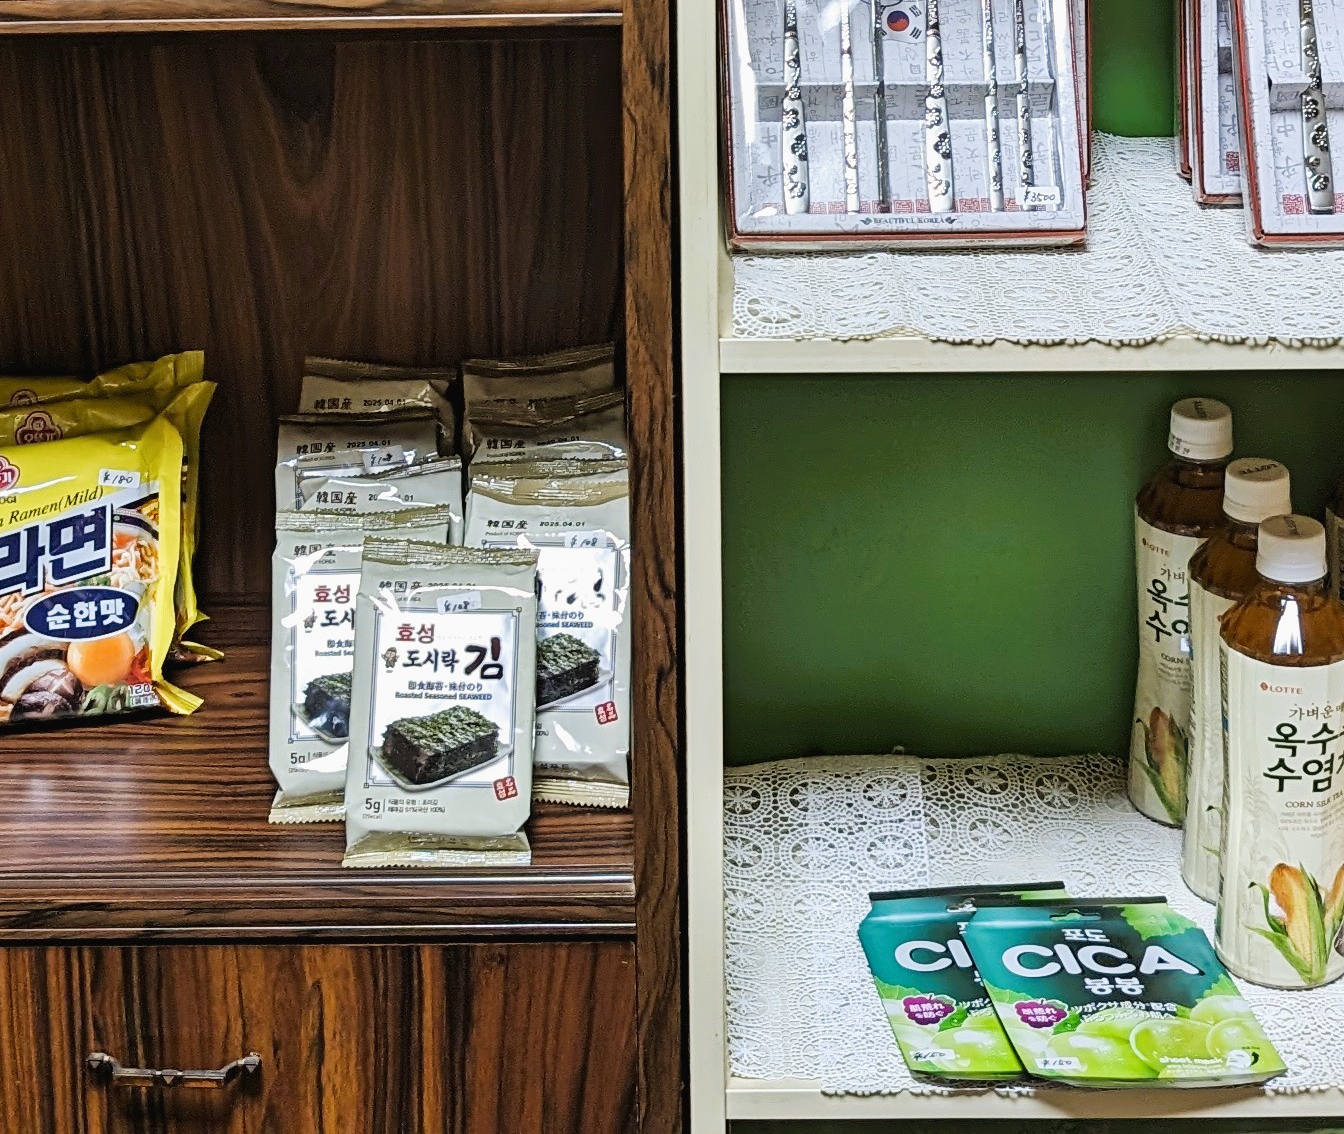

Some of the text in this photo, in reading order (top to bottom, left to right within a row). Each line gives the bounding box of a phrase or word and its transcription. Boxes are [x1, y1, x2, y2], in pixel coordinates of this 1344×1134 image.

[873, 217, 944, 225] BEAUTIFUL KOREA
[314, 397, 352, 410] 韓国産
[296, 442, 336, 454] 韓国産
[8, 485, 104, 524] Ramen(Mild)
[316, 491, 357, 504] 韓国産
[486, 519, 528, 529] 韓国産
[313, 584, 351, 604] 효성
[46, 598, 126, 631] 순한맛
[395, 623, 435, 644] 효성
[402, 637, 504, 680] 도시락 김
[395, 692, 423, 700] Roasted
[424, 692, 457, 700] Seasoned
[1269, 685, 1303, 695] LOTTE
[1289, 704, 1334, 721] 가벼운
[365, 798, 381, 813] 5g
[1285, 790, 1344, 809] CORN SILK TEA
[1061, 928, 1110, 943] 포도
[894, 939, 973, 972] CI
[1001, 943, 1201, 978] CICA
